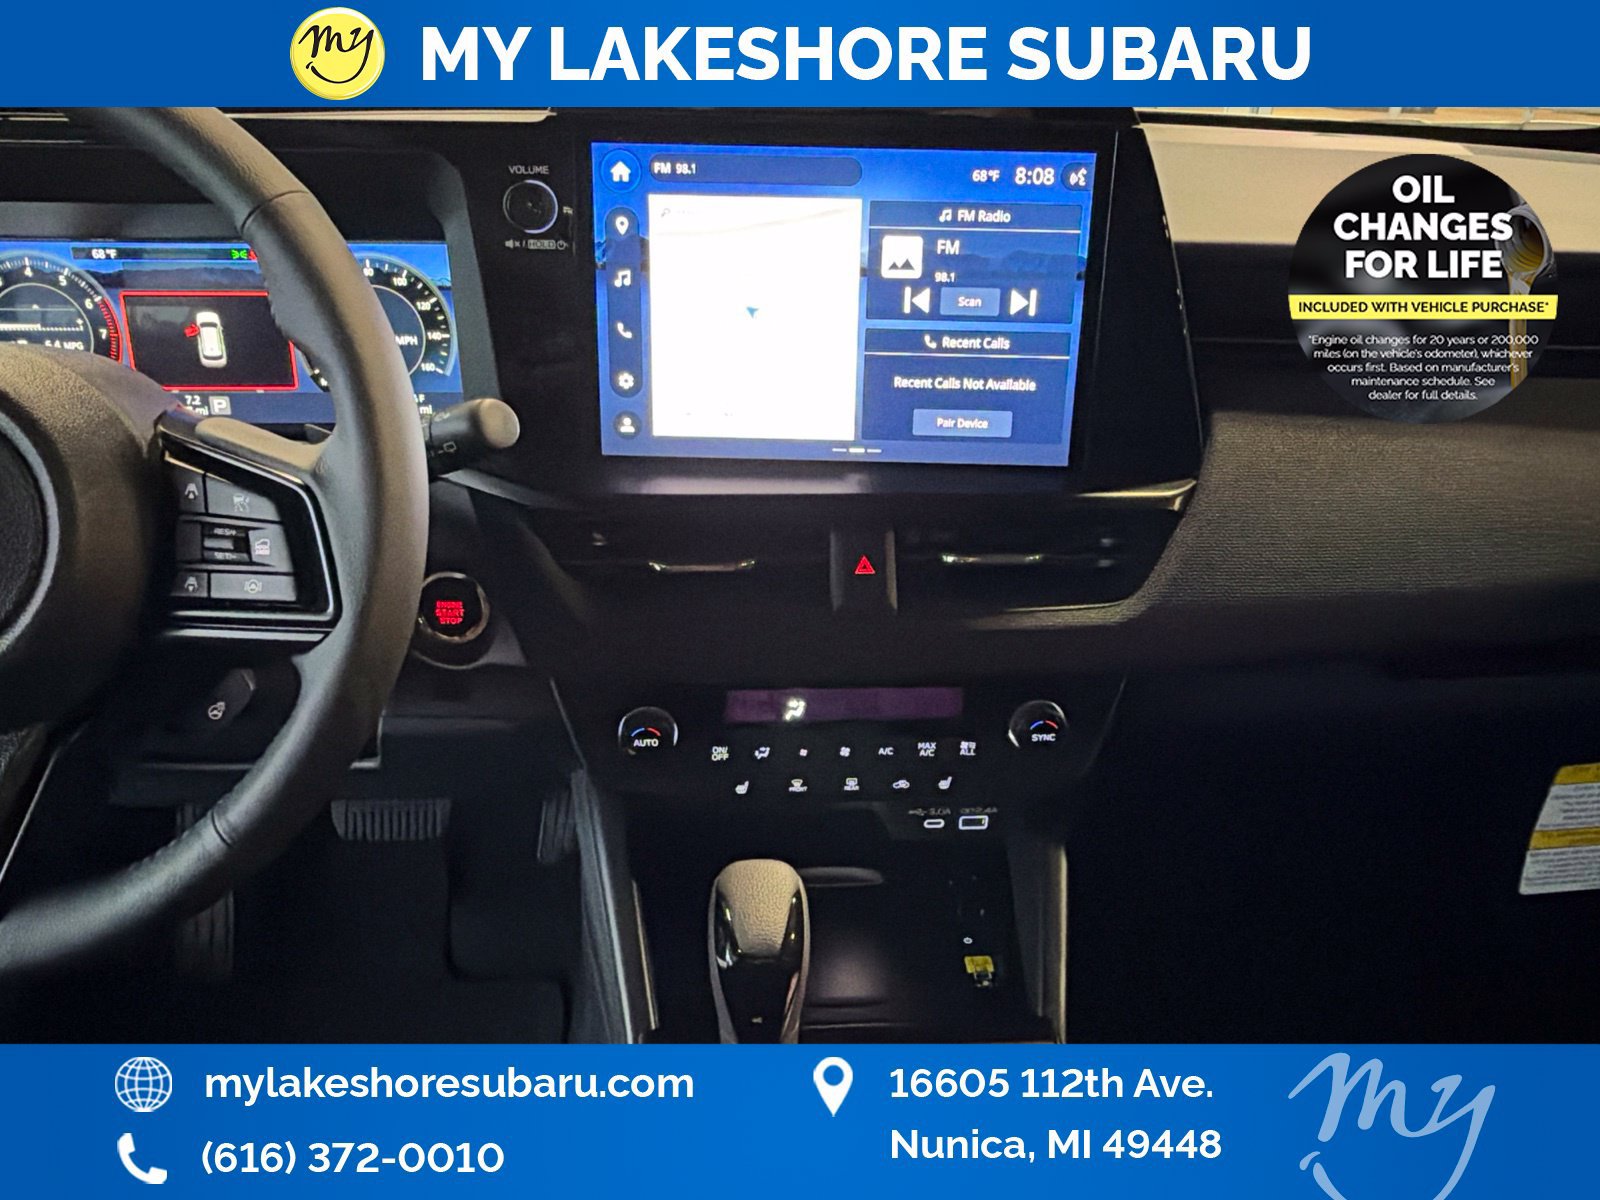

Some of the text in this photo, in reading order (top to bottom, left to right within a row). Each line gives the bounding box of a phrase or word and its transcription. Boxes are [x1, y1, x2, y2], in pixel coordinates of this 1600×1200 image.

[508, 165, 550, 175] VOLUME
[653, 162, 697, 175] FM 98.1
[971, 166, 1055, 186] 68°F 8:08
[956, 209, 1012, 223] FM Radio
[936, 239, 961, 256] FM
[23, 265, 34, 277] 4
[58, 274, 68, 286] 5
[392, 276, 408, 287] 100
[934, 271, 956, 283] 98.1
[84, 298, 94, 310] 6
[416, 300, 432, 311] 120
[957, 295, 982, 308] Scan
[98, 327, 108, 340] 7
[426, 331, 442, 341] 140
[63, 340, 84, 351] MPG
[395, 335, 419, 346] MPH
[941, 336, 1011, 350] Recent Calls
[893, 376, 1037, 392] Recent Calls Not Available
[184, 394, 202, 405] 7.2
[419, 404, 433, 415] mi
[936, 417, 989, 430] Pair Device
[435, 608, 465, 617] START
[439, 617, 463, 625] STOP
[1031, 732, 1057, 742] SYNC
[632, 738, 660, 748] AUTO
[917, 741, 937, 750] MAX
[711, 745, 729, 754] ON/
[878, 746, 895, 756] A/C
[918, 748, 936, 757] A/C
[959, 747, 977, 756] ALL
[711, 753, 730, 761] OFF
